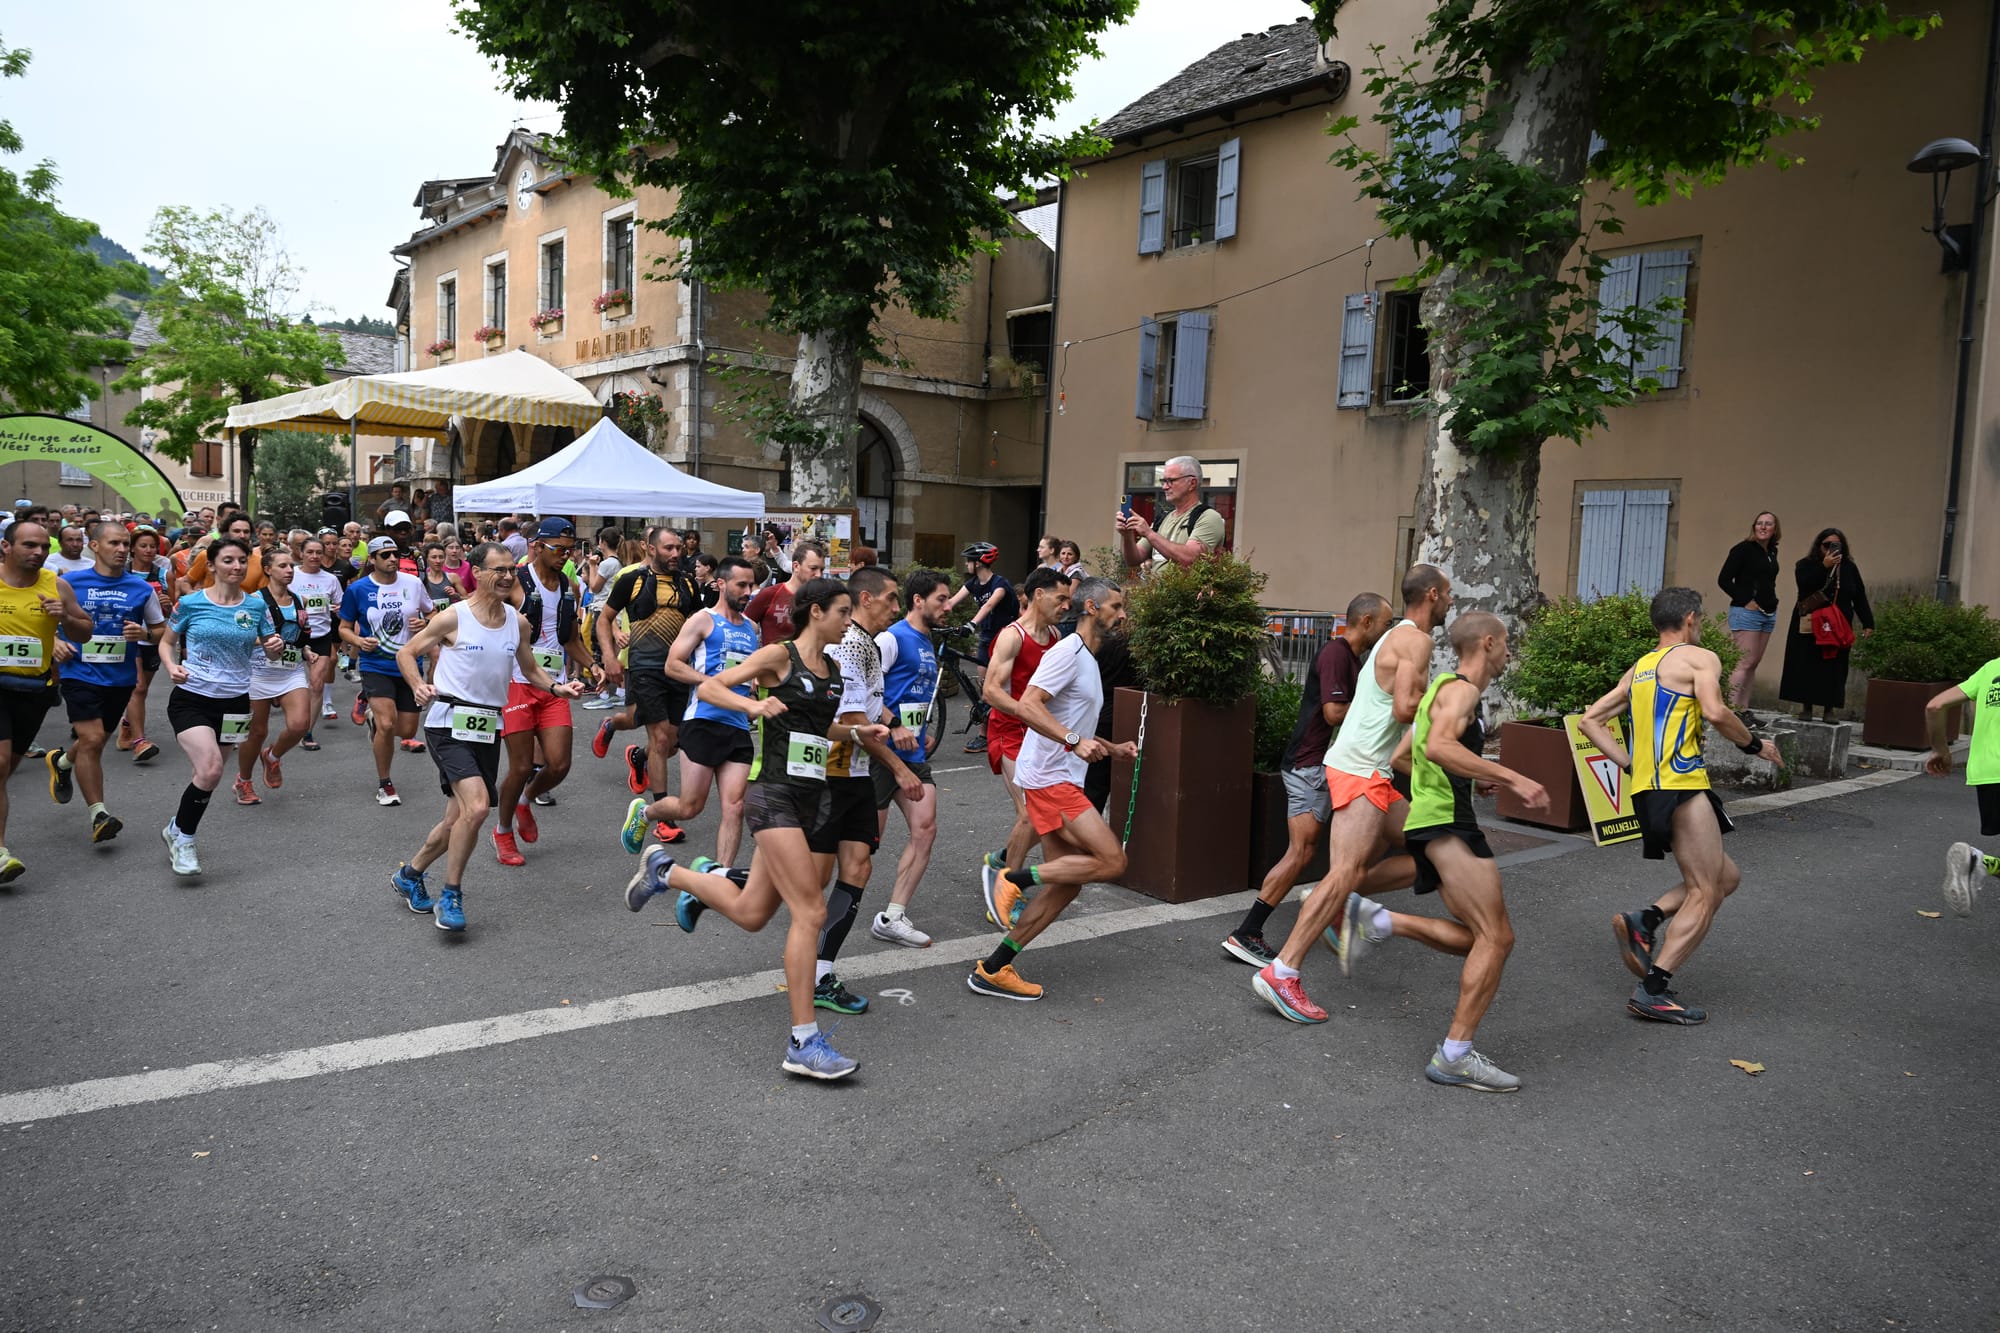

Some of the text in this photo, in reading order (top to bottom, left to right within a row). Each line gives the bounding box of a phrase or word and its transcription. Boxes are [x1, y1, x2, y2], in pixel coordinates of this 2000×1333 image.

[575, 325, 651, 360] MAIRIE
[69, 434, 93, 443] des
[40, 444, 102, 454] cévenoles
[380, 601, 403, 610] ASSP
[4, 643, 29, 657] 15
[94, 642, 117, 654] 77
[543, 655, 552, 668] 2
[465, 716, 488, 731] 82
[802, 745, 822, 765] 56
